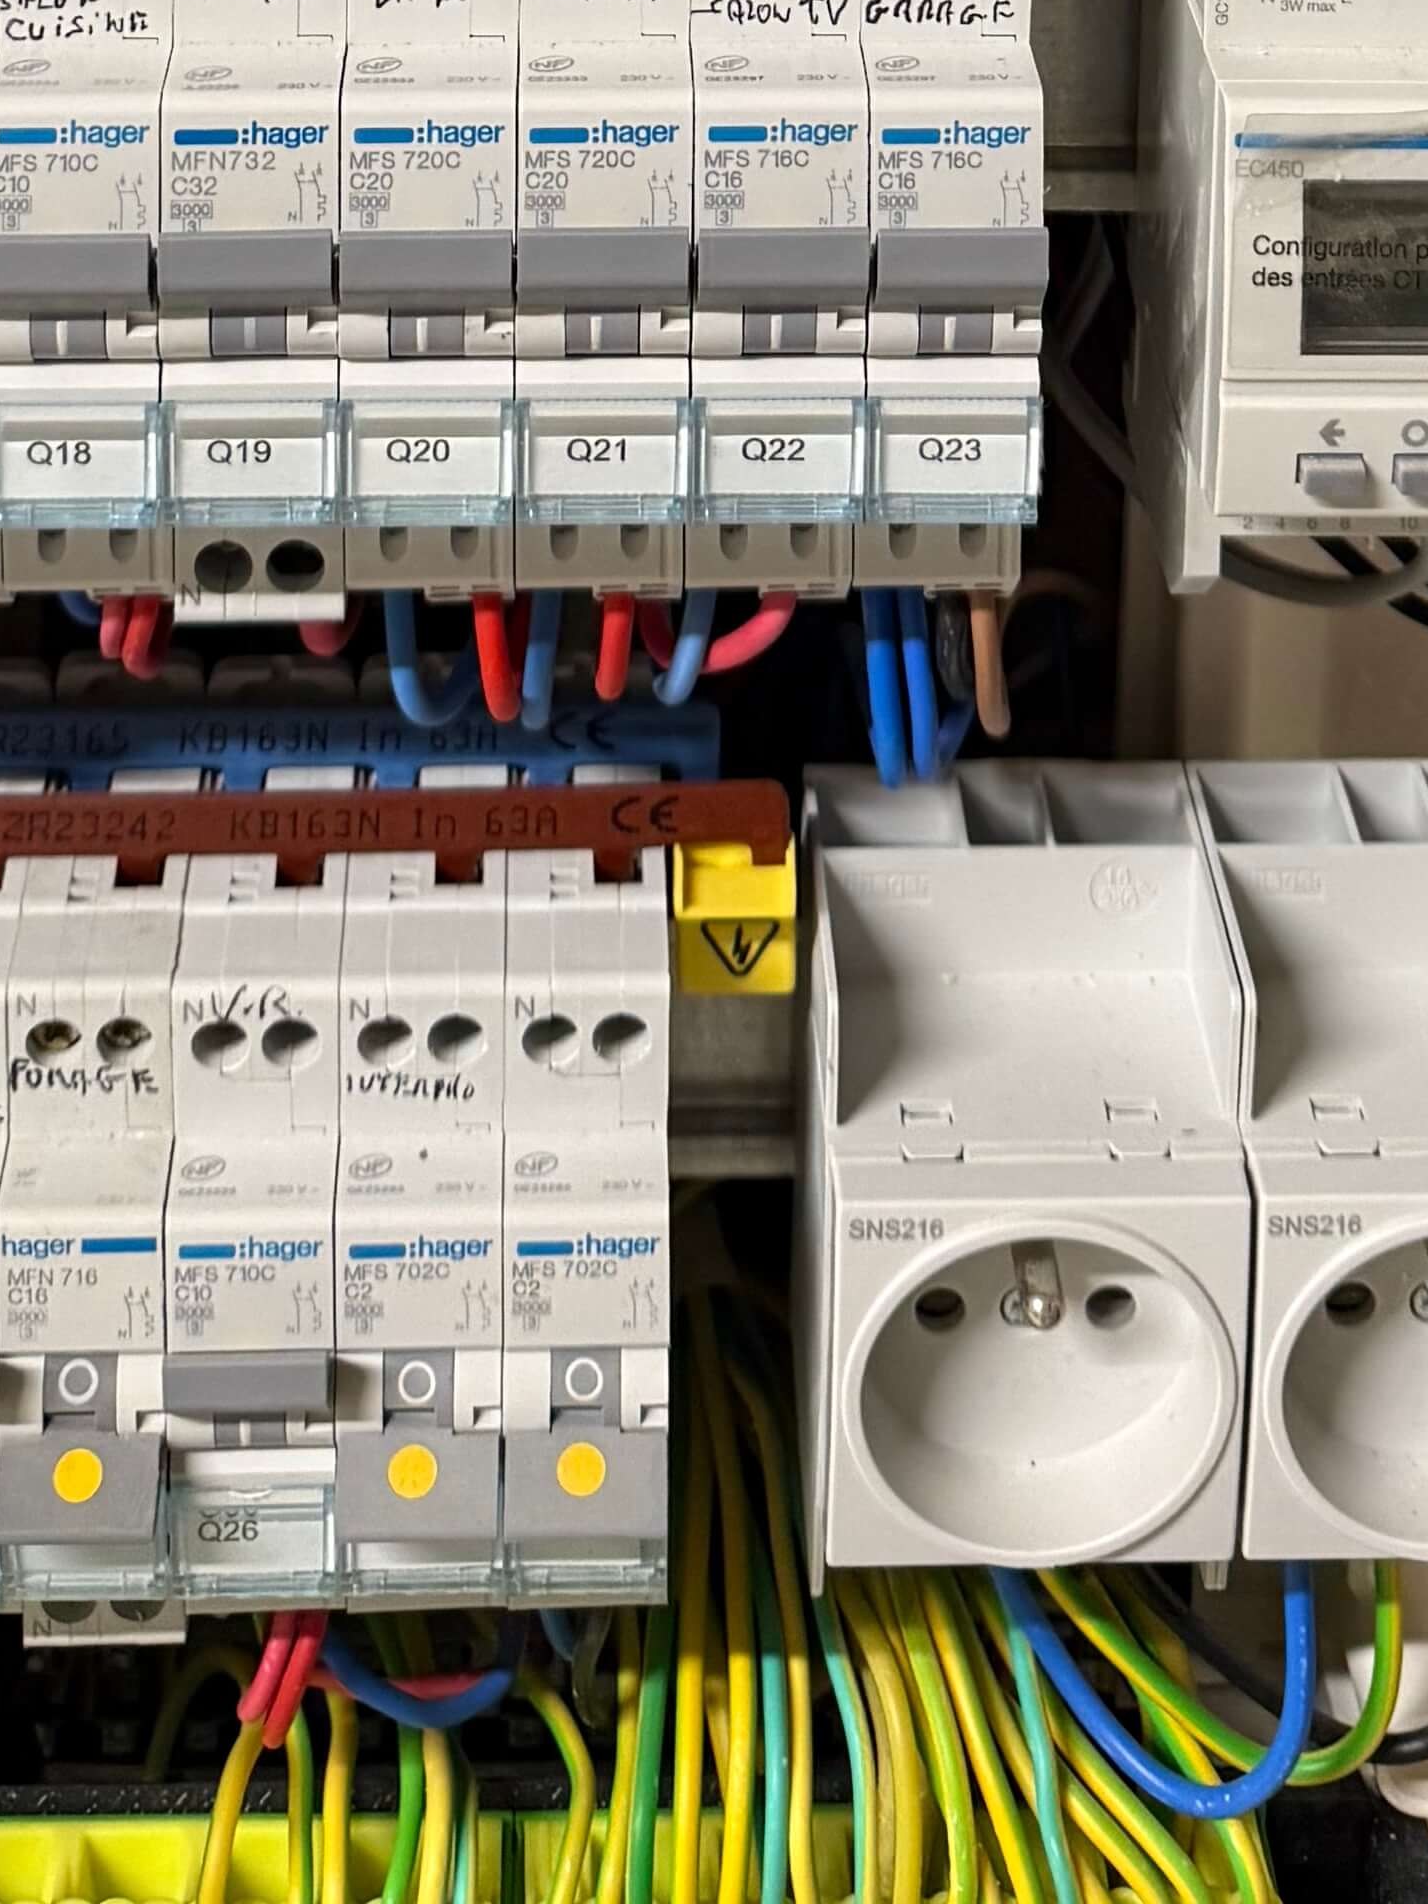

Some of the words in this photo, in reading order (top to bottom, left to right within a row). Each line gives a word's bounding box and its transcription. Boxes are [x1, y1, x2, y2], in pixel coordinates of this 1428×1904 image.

[1279, 0, 1303, 13] 3W
[1306, 1, 1336, 14] max
[171, 152, 275, 170] MFN732
[525, 150, 570, 168] MFS
[578, 150, 635, 168] 720C
[1235, 159, 1304, 179] EC450
[171, 176, 217, 196] C32
[525, 170, 569, 190] C20
[1252, 235, 1408, 263] Configuration
[1251, 268, 1293, 289] des
[1302, 269, 1386, 291] entrées
[1392, 270, 1427, 290] CT
[26, 441, 92, 467] Q18
[206, 440, 272, 465] Q19
[386, 439, 451, 464] Q20
[566, 438, 628, 462] Q21
[741, 438, 806, 461] Q22
[919, 438, 982, 461] Q23
[848, 1218, 944, 1241] SNS216
[1267, 1213, 1363, 1237] SNS216
[1, 1234, 75, 1258] hager
[8, 1269, 57, 1287] MFN
[60, 1268, 98, 1287] 716
[198, 1520, 259, 1543] Q26
